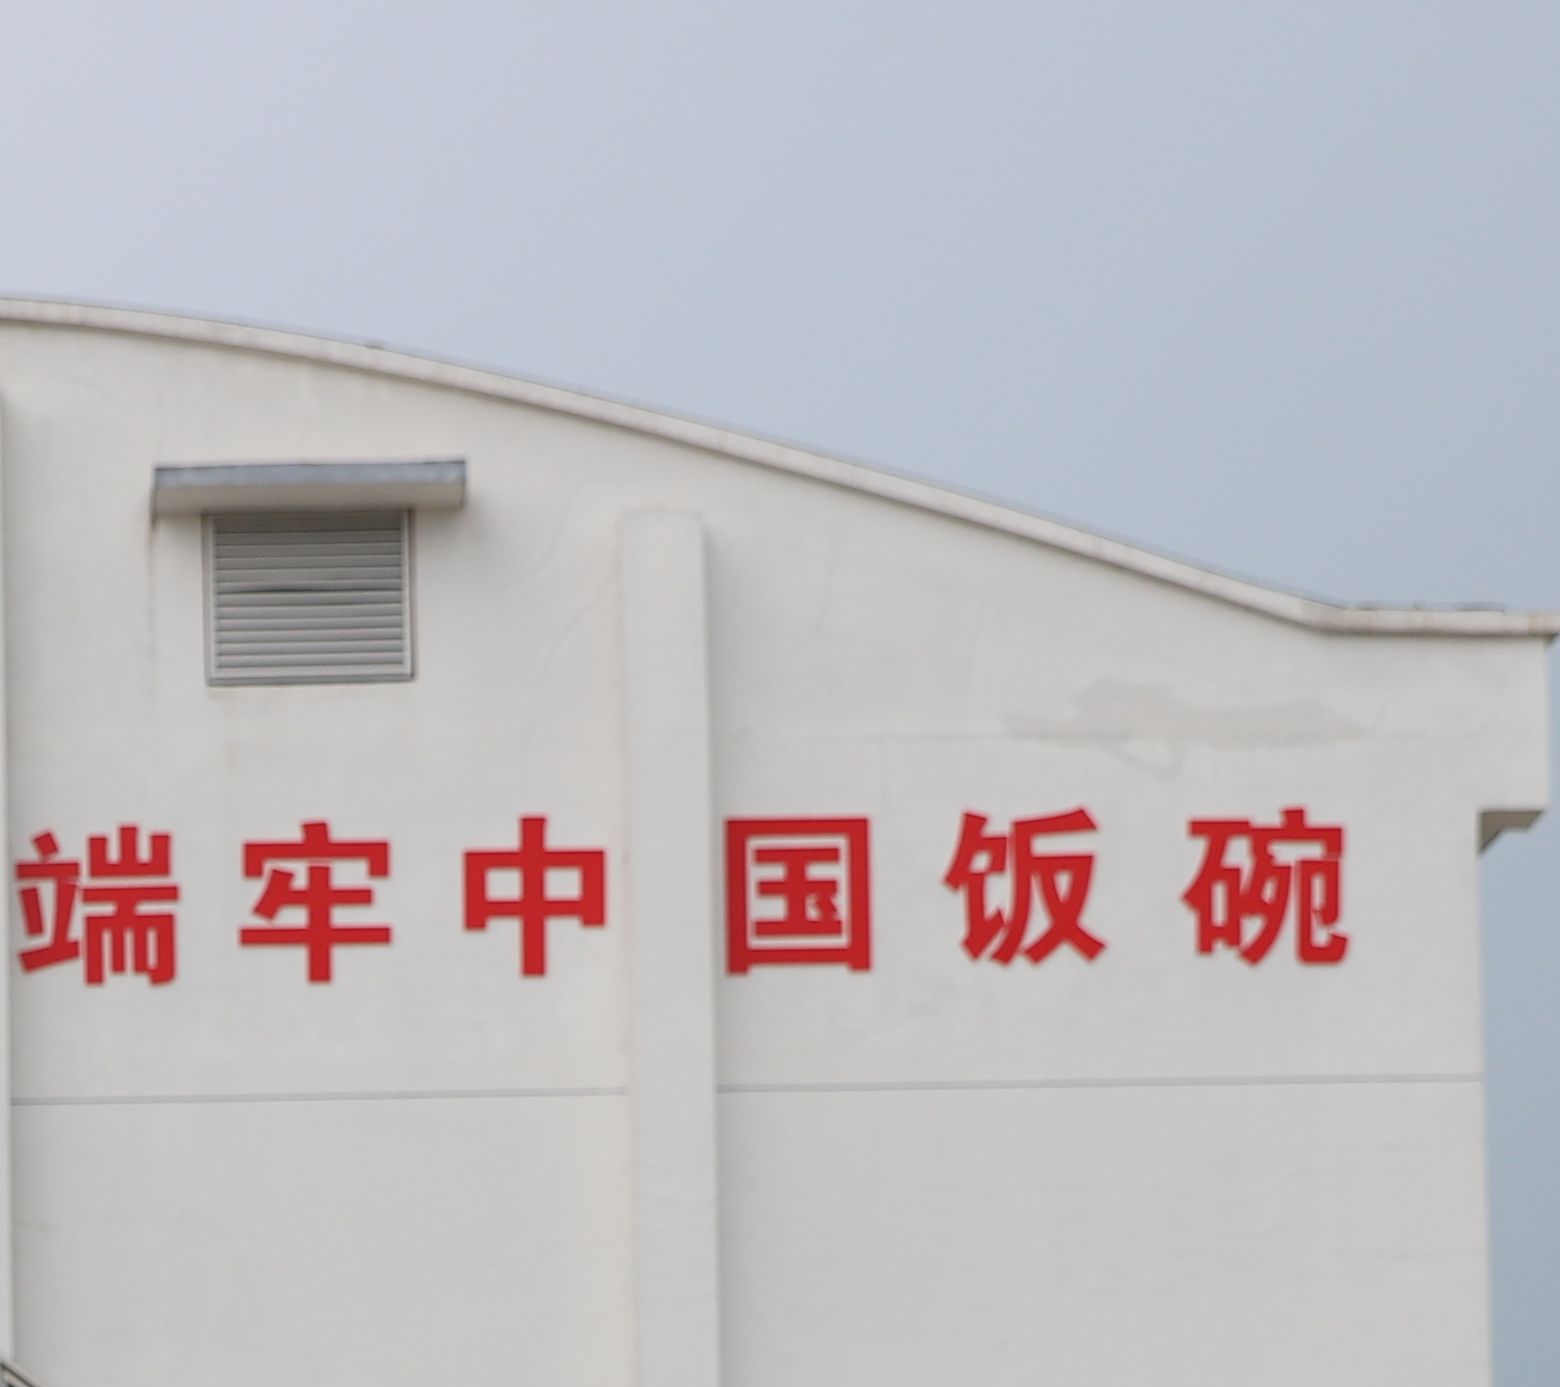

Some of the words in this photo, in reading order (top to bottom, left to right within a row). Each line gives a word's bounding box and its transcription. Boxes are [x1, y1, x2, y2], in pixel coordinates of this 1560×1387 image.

[16, 809, 1350, 987] 端牢中国饭碗
